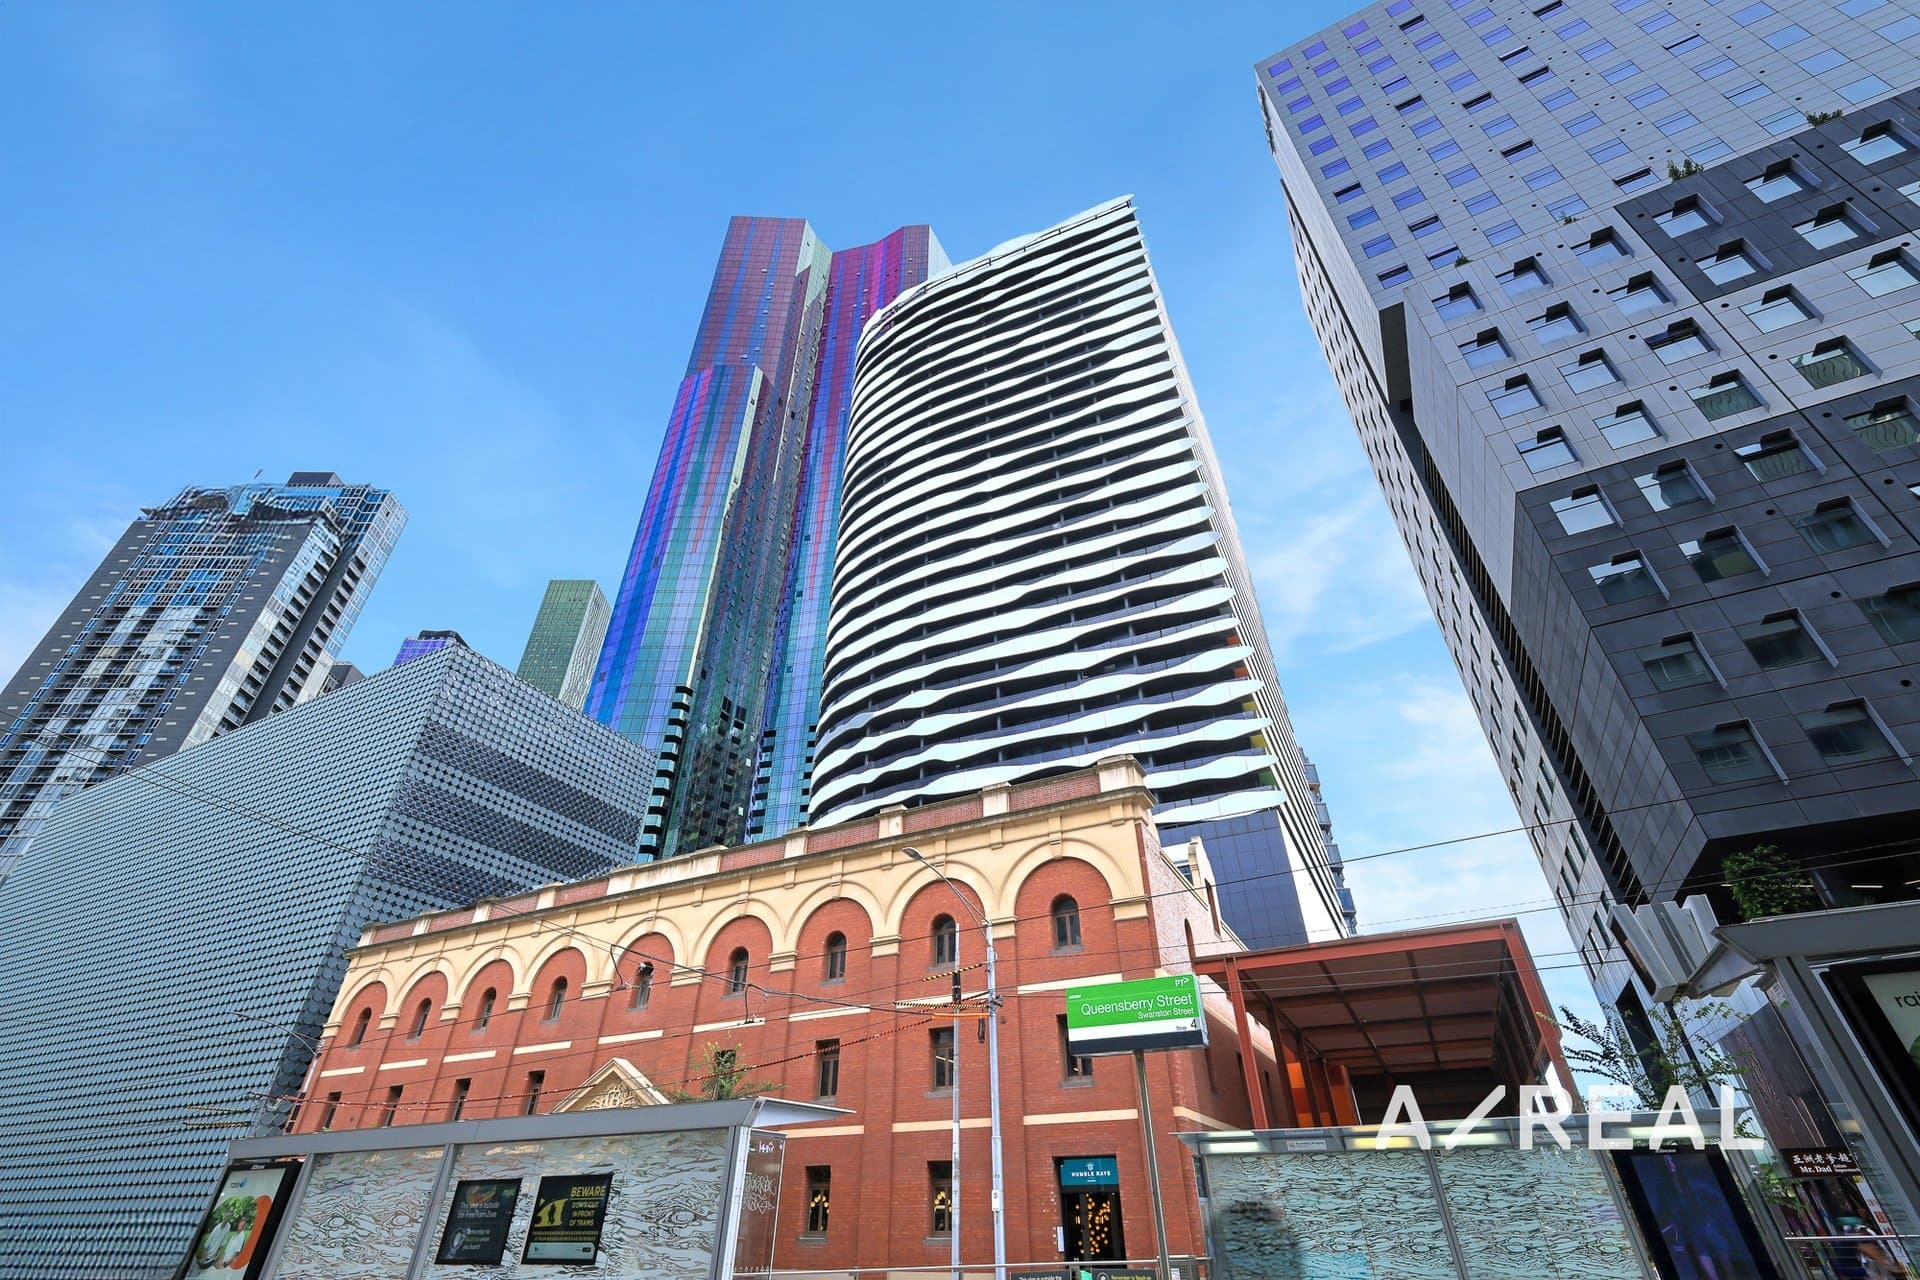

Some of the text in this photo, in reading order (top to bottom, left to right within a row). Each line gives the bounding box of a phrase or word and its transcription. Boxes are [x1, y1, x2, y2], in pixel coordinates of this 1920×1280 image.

[1081, 993, 1193, 1015] Queensberry Street
[1137, 1006, 1195, 1020] Swanston Street
[1190, 1018, 1197, 1029] 4
[1799, 1165, 1833, 1173] Mr. Dad
[570, 1185, 607, 1197] BEWARE
